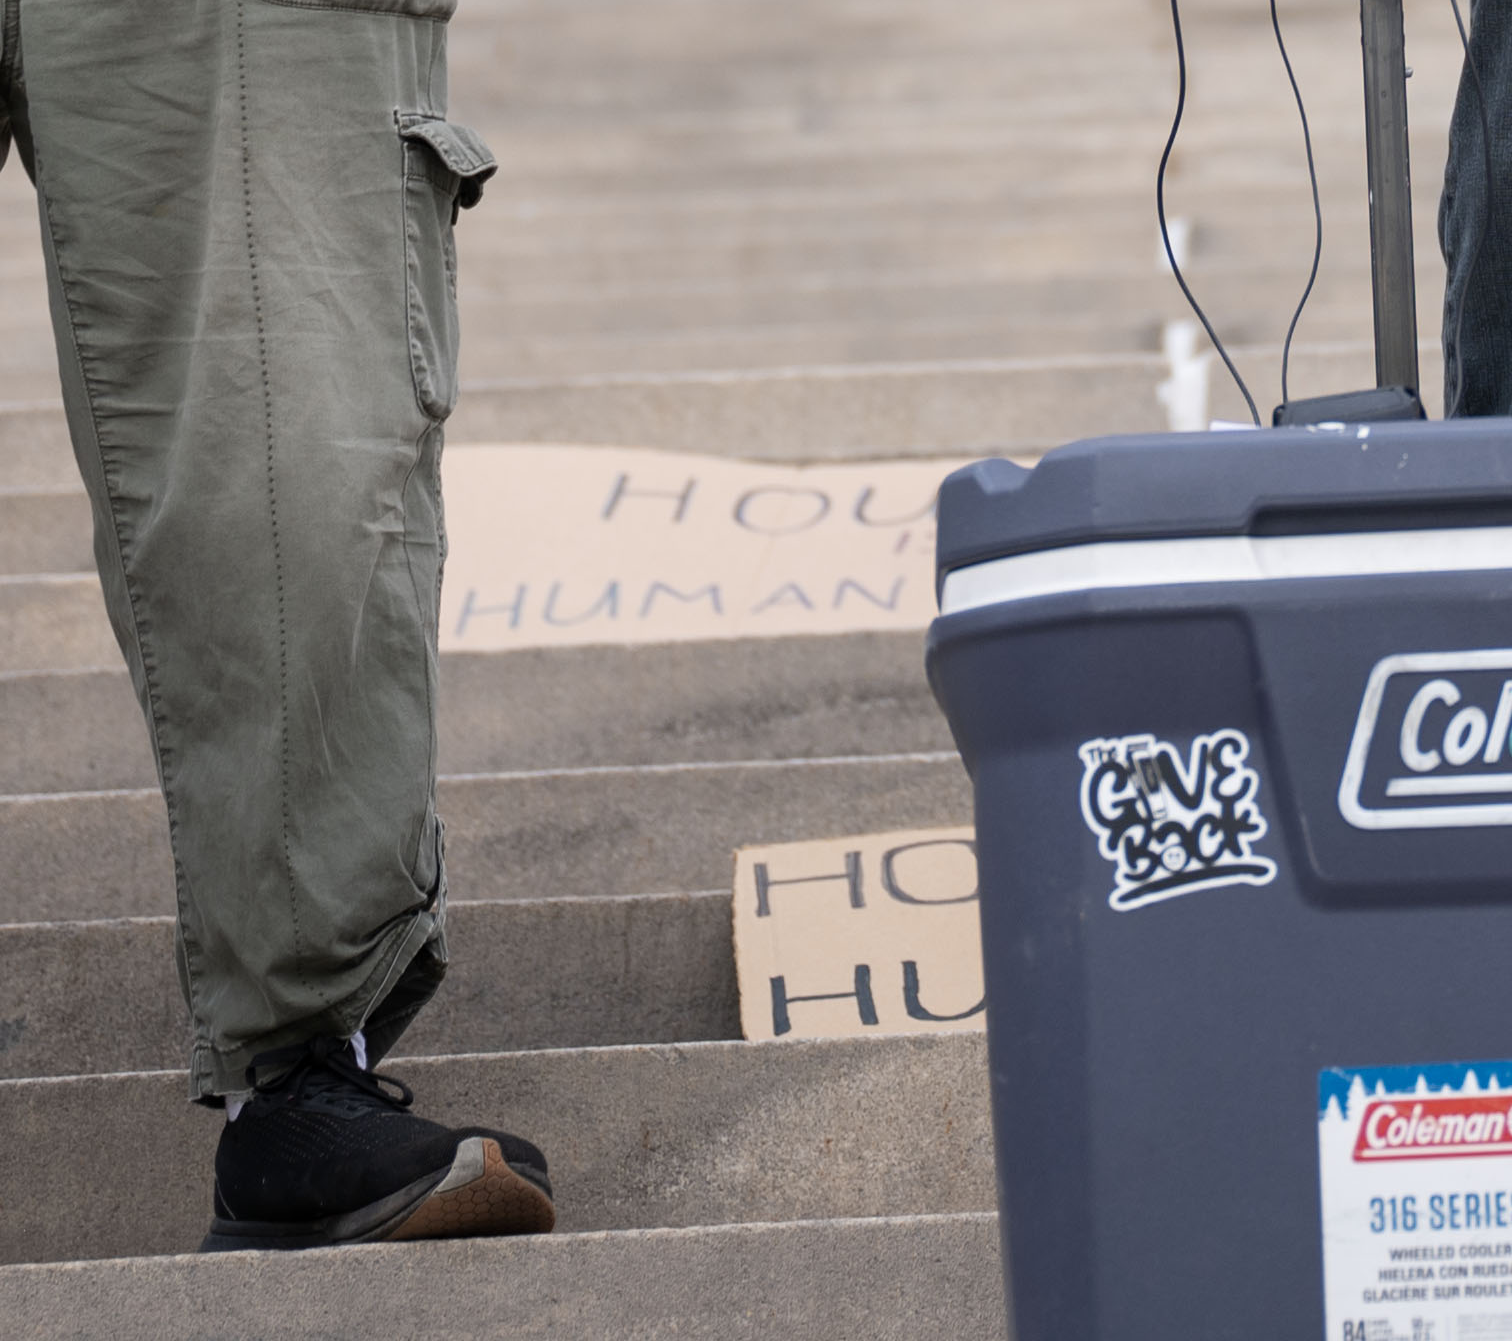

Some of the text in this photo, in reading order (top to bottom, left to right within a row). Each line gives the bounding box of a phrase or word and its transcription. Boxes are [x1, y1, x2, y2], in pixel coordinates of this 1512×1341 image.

[453, 577, 907, 639] HUMAN
[752, 838, 979, 918] HO
[1364, 1103, 1506, 1149] Coleman
[1369, 1195, 1419, 1234] 316
[1389, 1242, 1512, 1262] WHEELED COOLER
[1378, 1265, 1434, 1283] HIELERA
[1439, 1264, 1468, 1279] CON
[1433, 1283, 1461, 1300] SUR
